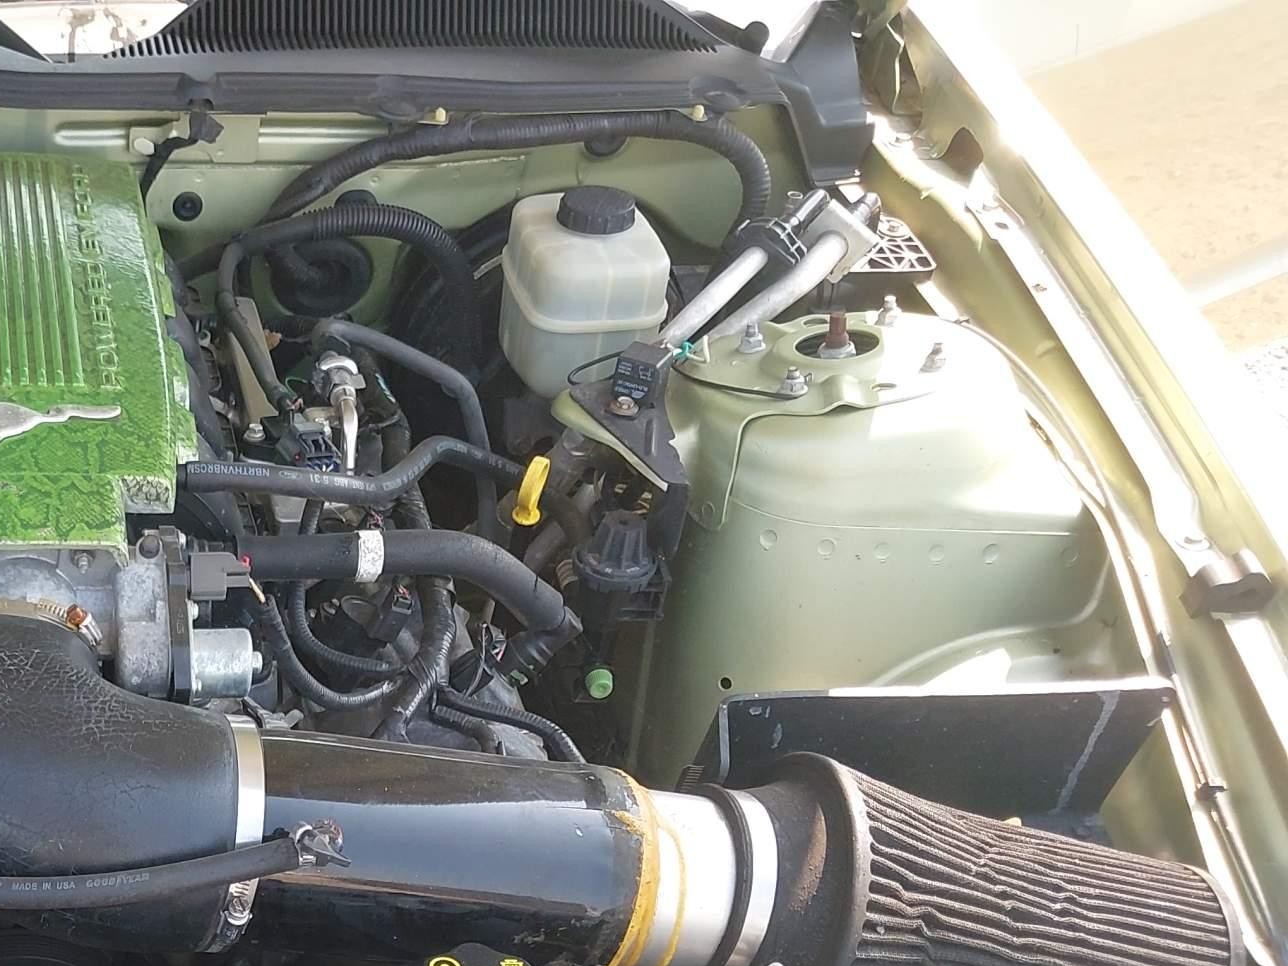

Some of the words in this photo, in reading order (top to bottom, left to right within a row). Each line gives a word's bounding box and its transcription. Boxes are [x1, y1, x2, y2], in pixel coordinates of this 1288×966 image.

[77, 222, 104, 257] BY
[87, 262, 125, 391] POWERED
[11, 882, 38, 892] MADE
[42, 881, 52, 891] IN
[56, 880, 76, 890] USA
